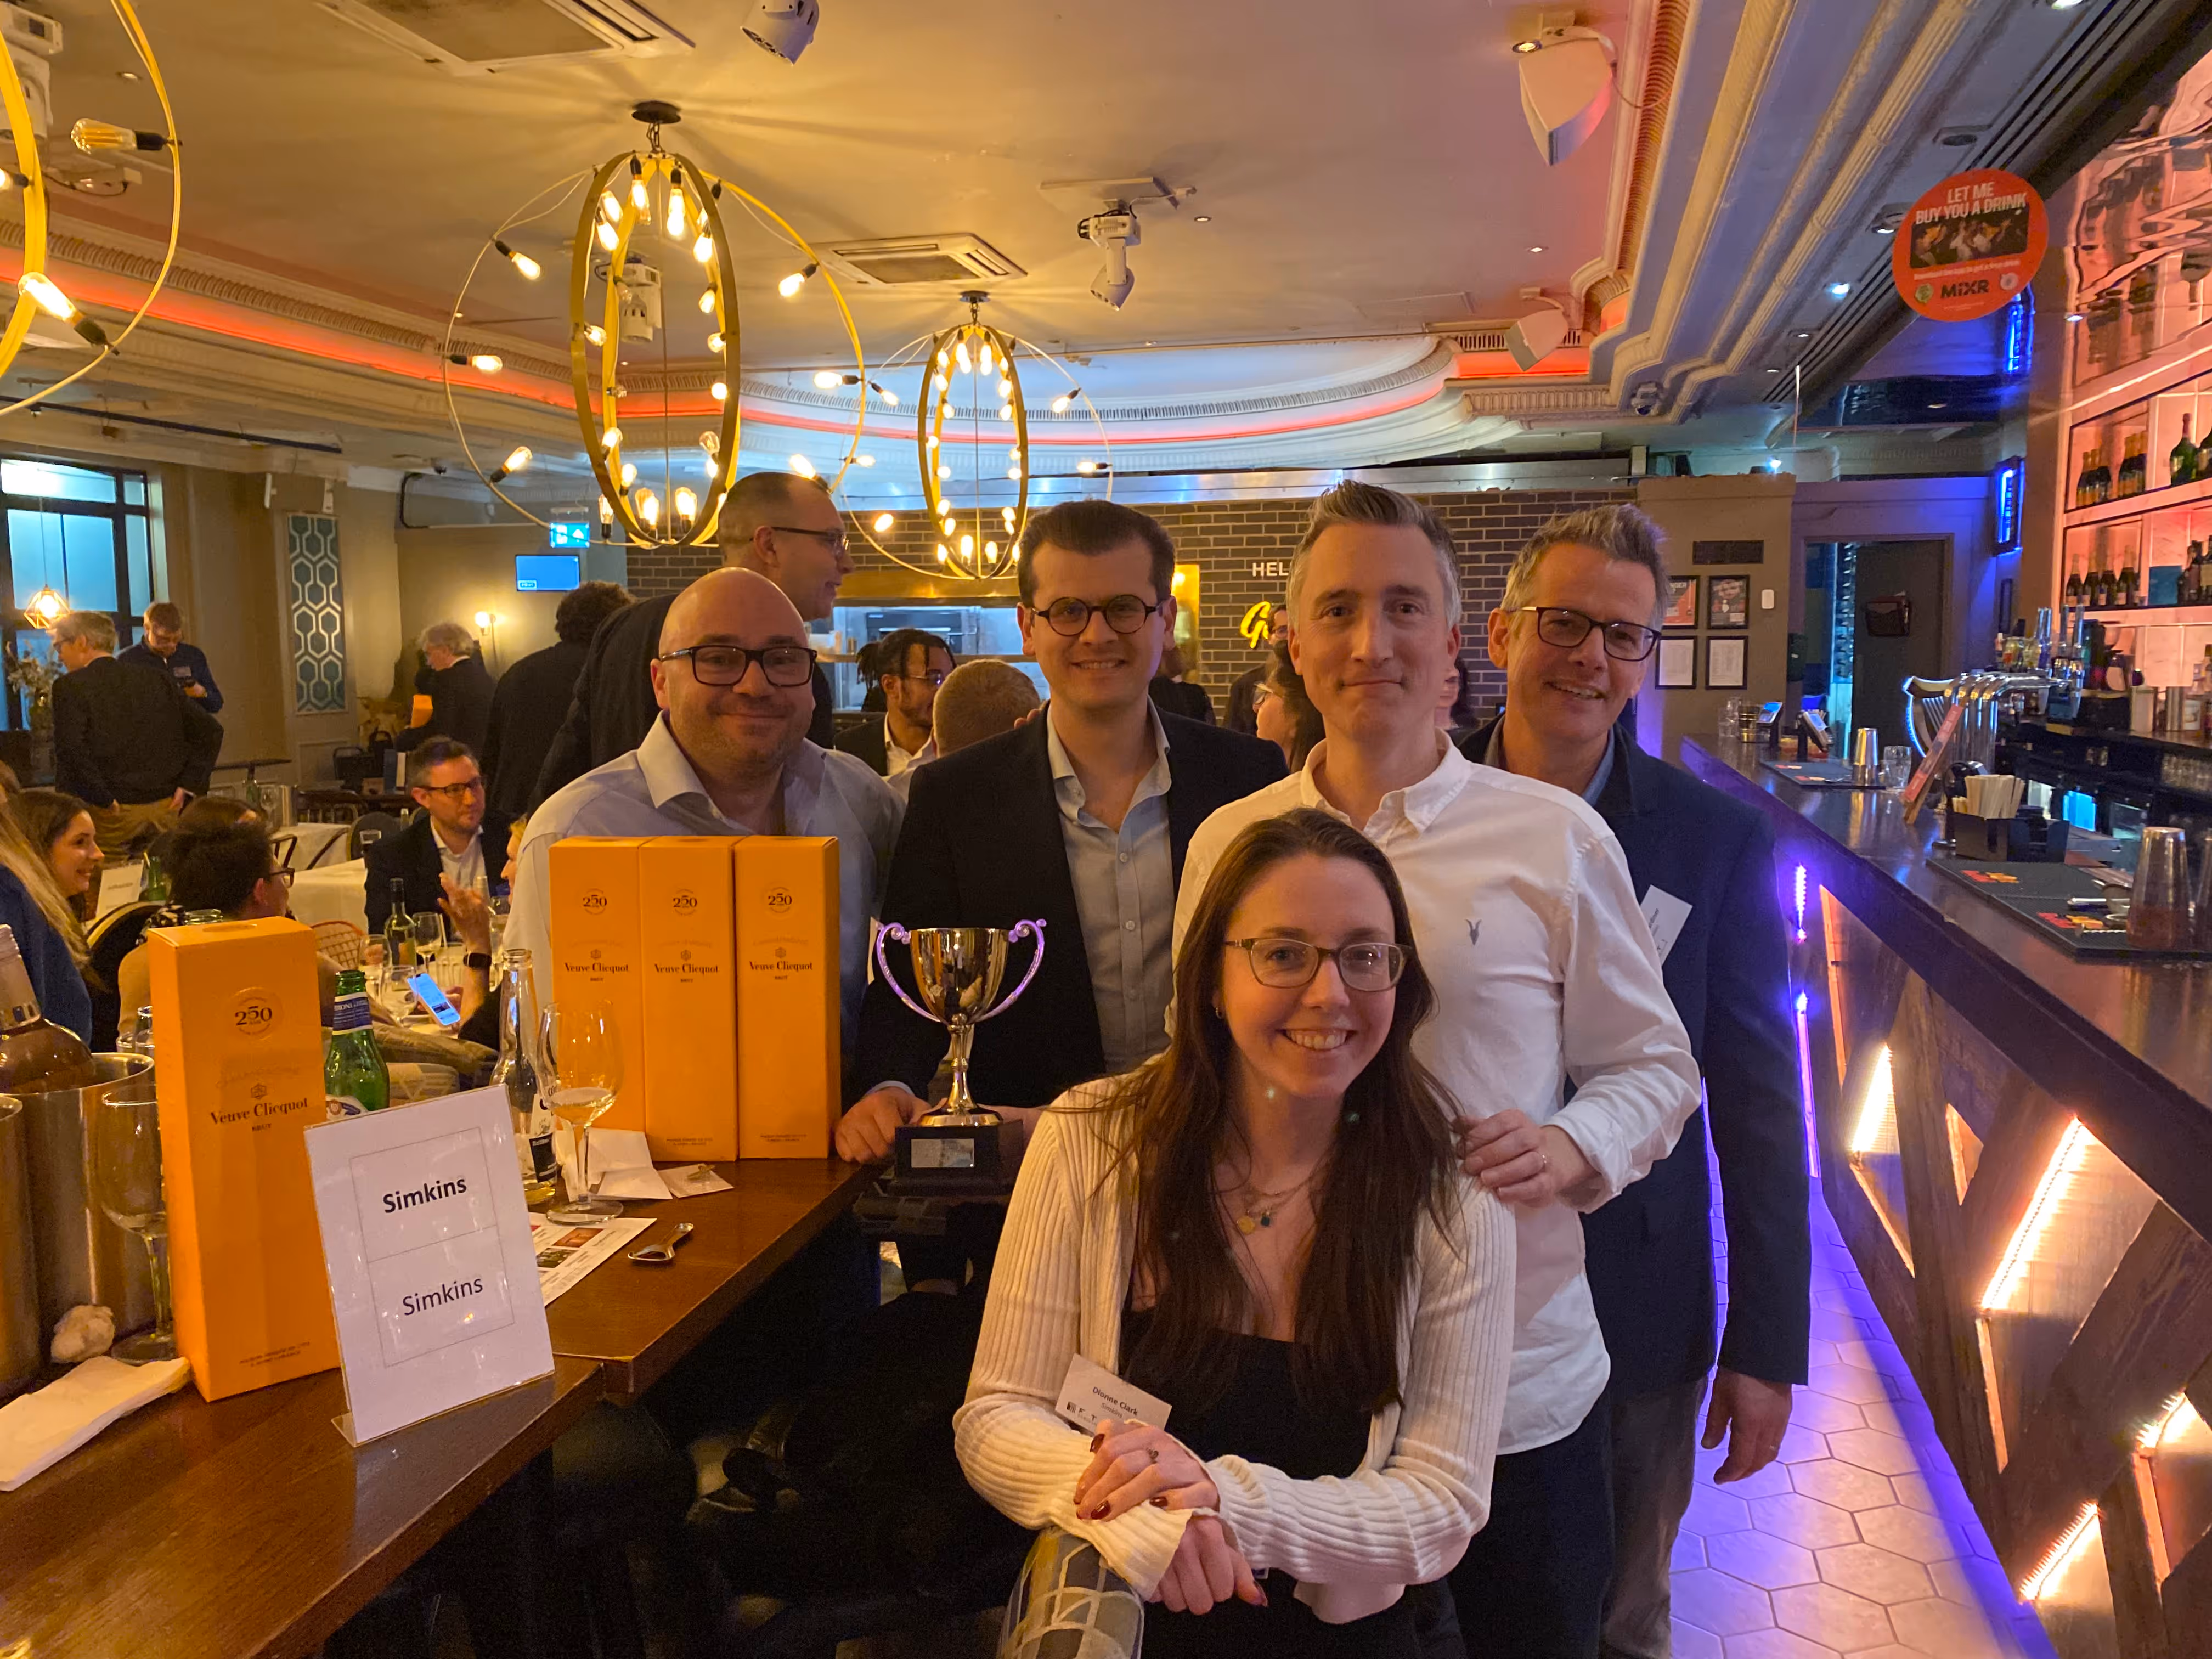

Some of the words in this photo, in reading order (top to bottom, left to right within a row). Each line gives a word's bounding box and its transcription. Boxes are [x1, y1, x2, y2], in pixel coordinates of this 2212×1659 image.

[1948, 185, 1970, 203] LET
[1972, 182, 1994, 199] ME
[1916, 207, 1943, 224] BUY
[1944, 202, 1969, 219] YOU
[1970, 201, 1982, 215] A
[1984, 193, 2027, 213] DRINK
[583, 894, 607, 907] 250
[673, 895, 697, 907] 250
[768, 893, 792, 905] 250
[565, 962, 590, 972] Veuve
[592, 962, 628, 974] Clicquot
[654, 963, 680, 973] Veuve
[682, 963, 718, 975] Clicquot
[749, 961, 774, 970] Veuve
[776, 961, 812, 972] Clicquot
[235, 1006, 273, 1025] 250
[211, 1110, 250, 1124] Veuve
[253, 1097, 308, 1116] Clicquot
[383, 1177, 467, 1214] Simkins
[402, 1278, 483, 1316] Simkins
[1092, 1386, 1118, 1405] Dionne
[1119, 1402, 1138, 1417] Clark
[1100, 1402, 1123, 1419] Simkins
